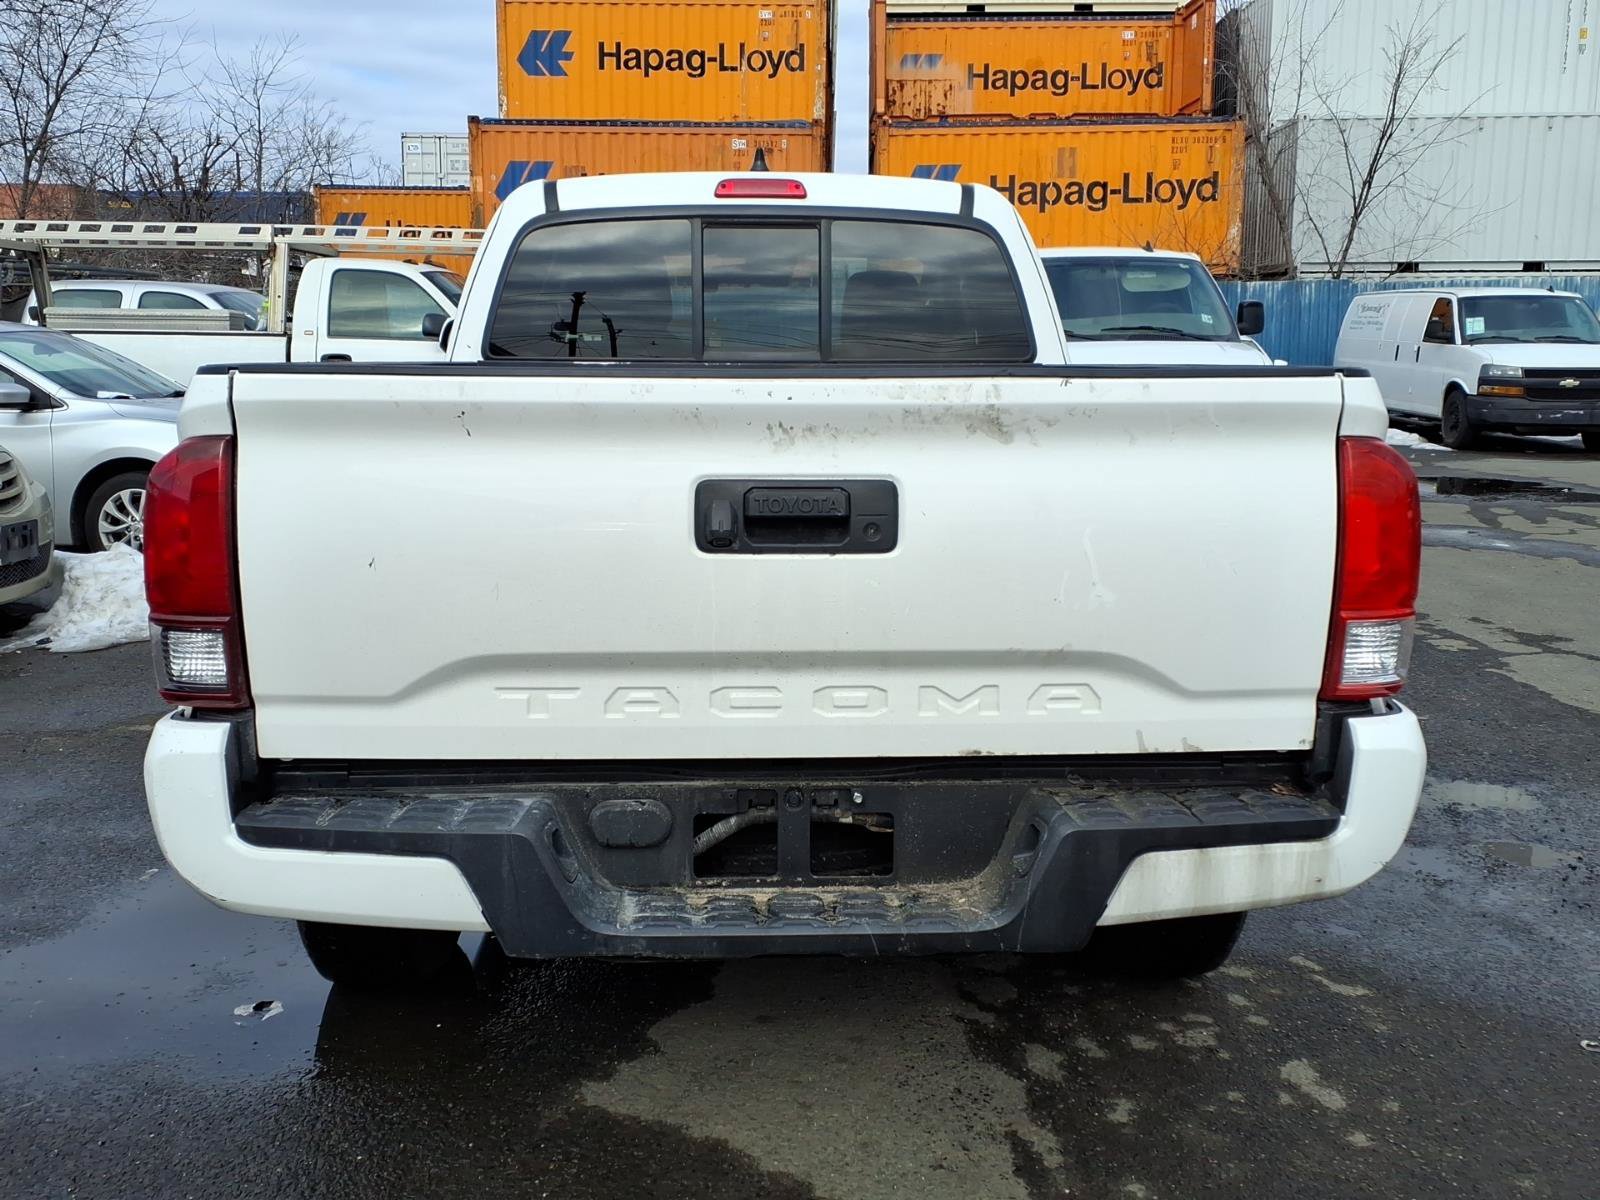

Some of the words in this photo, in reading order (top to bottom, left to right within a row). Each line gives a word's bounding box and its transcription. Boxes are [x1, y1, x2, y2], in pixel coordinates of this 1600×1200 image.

[598, 41, 805, 78] Hapag-Lloyd
[967, 62, 1164, 97] Hapag-Lloyd
[990, 171, 1219, 214] Hapag-Lloyd
[754, 495, 842, 514] TOYOTA
[494, 683, 1103, 719] TACOMA
